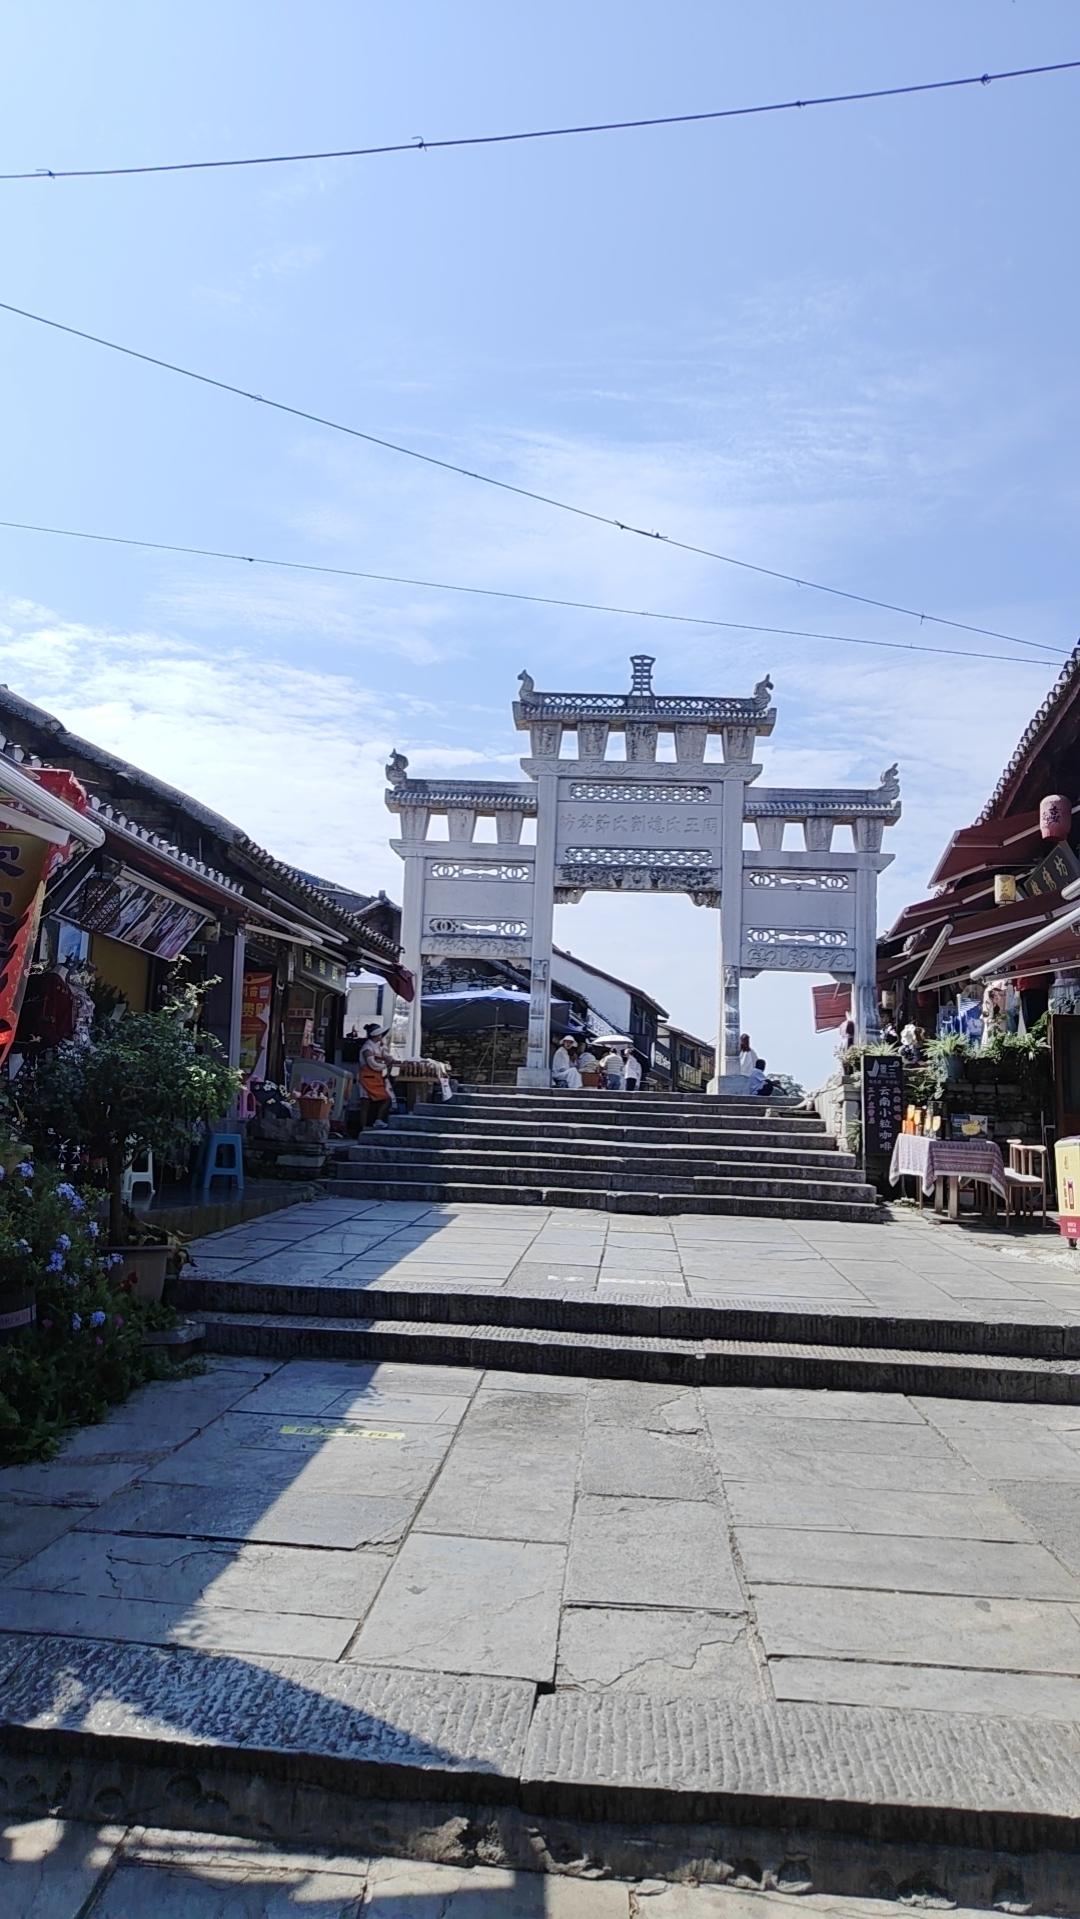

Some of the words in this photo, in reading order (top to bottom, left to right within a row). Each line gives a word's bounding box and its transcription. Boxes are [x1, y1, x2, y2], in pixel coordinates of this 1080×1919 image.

[879, 1086, 893, 1152] 云南小粒咖啡
